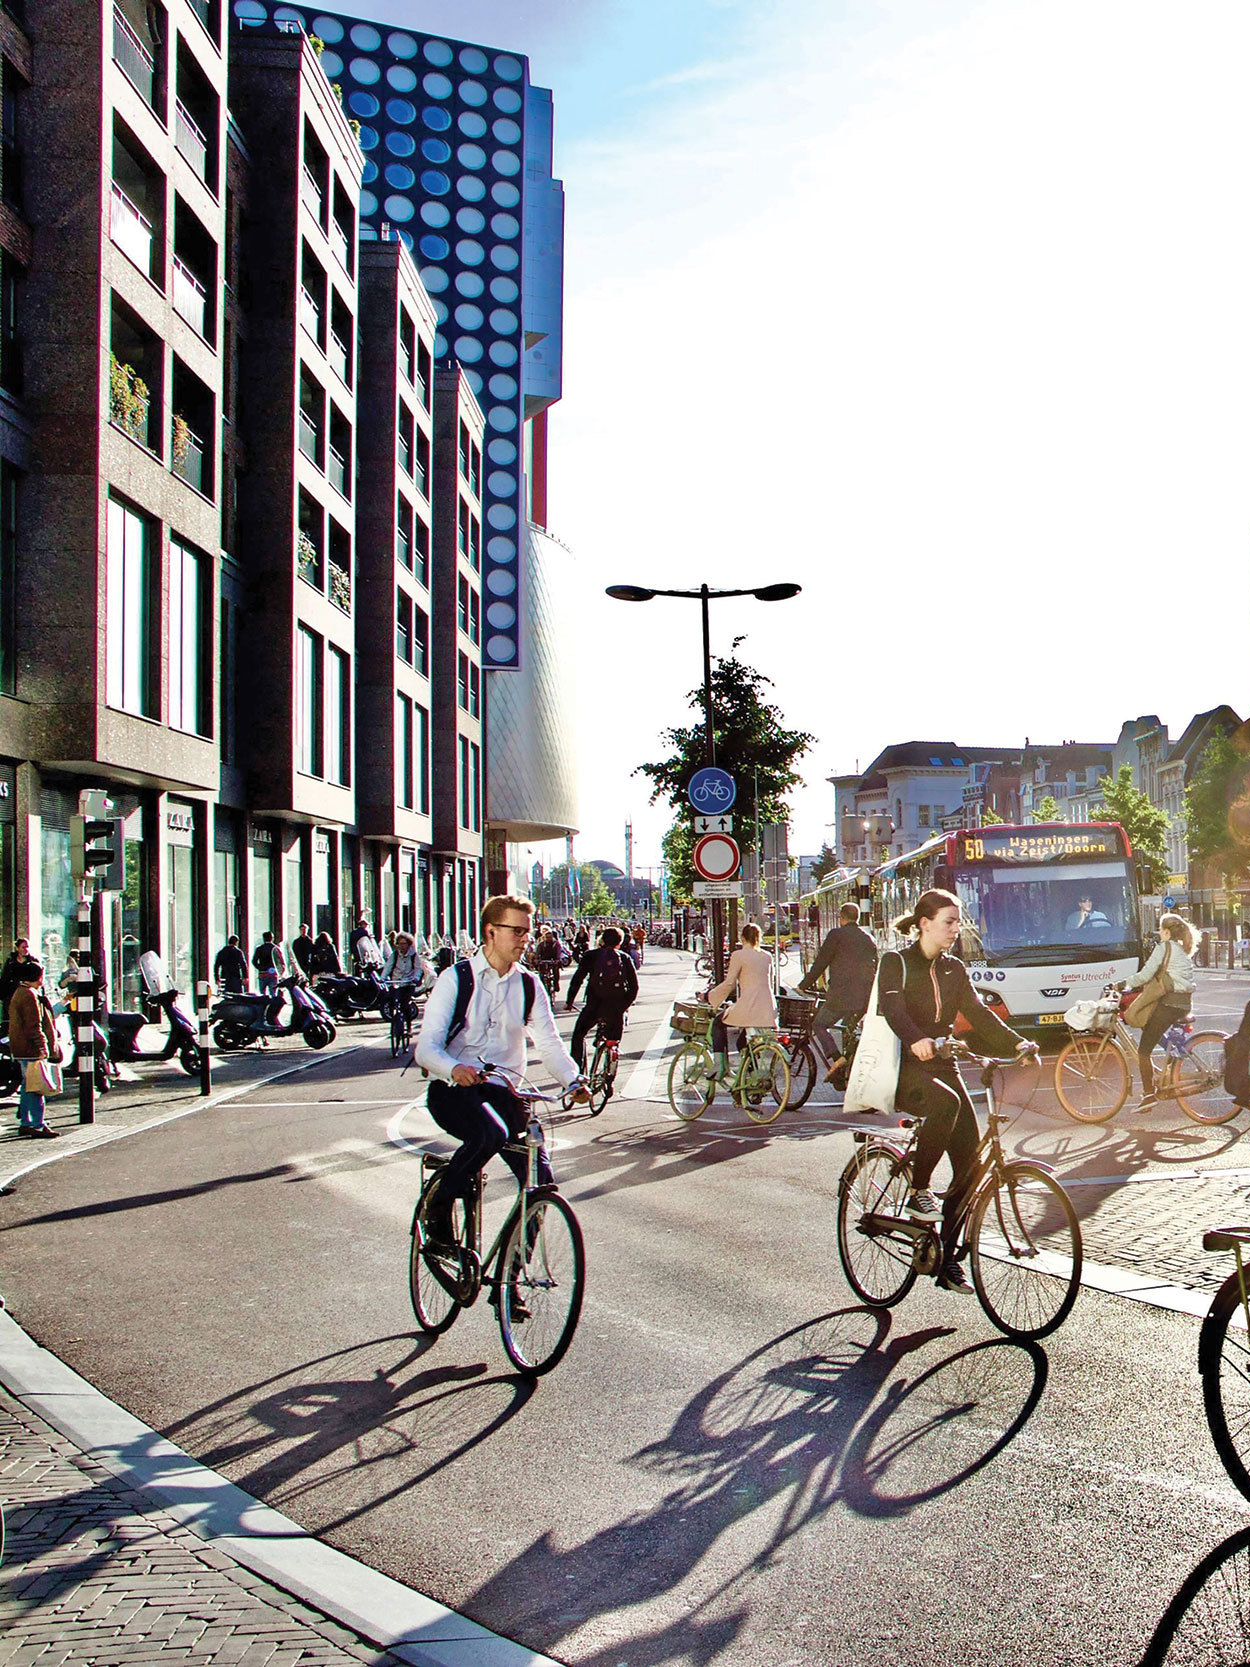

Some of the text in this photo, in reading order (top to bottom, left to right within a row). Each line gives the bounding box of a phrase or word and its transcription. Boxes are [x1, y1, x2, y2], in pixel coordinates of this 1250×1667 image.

[1009, 835, 1089, 847] Wageningen
[964, 839, 984, 860] 50
[994, 843, 1106, 857] via Zeist/Doorn
[1082, 970, 1112, 982] Utrecht
